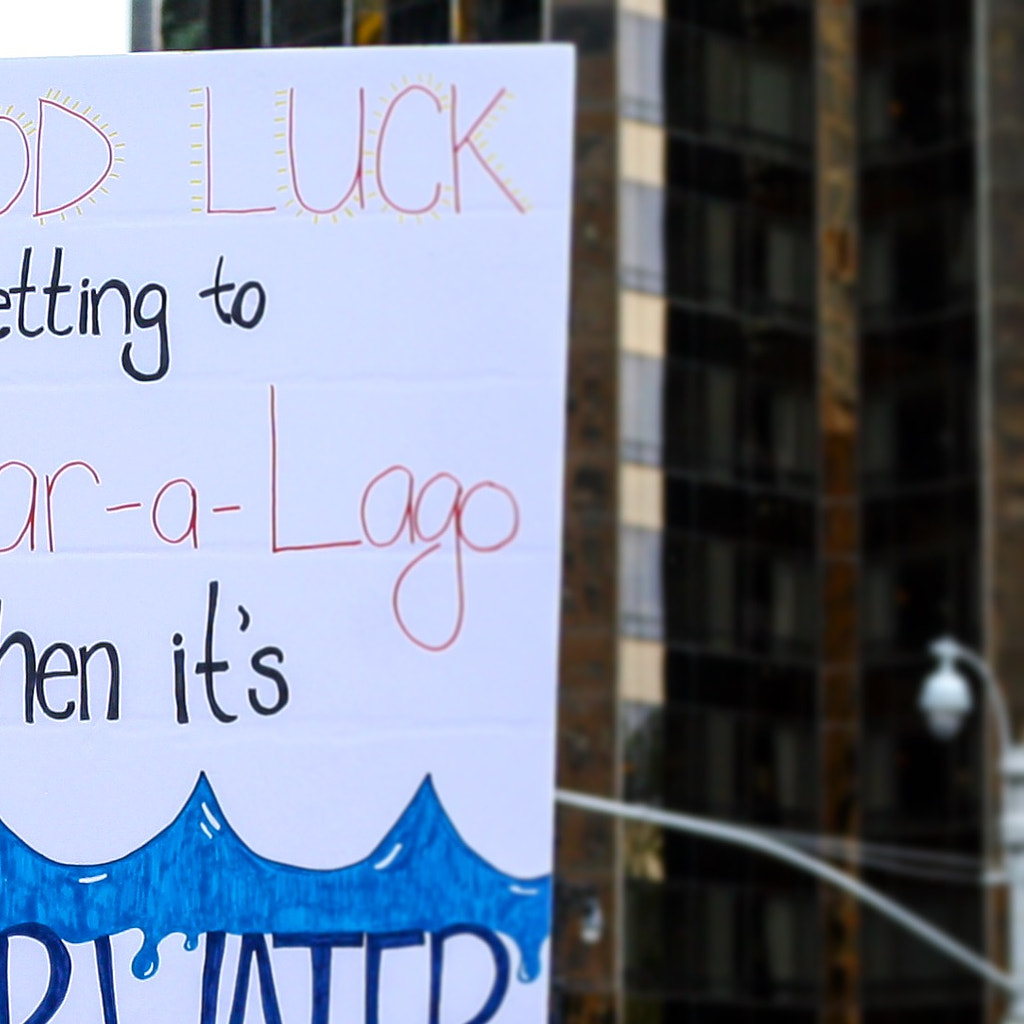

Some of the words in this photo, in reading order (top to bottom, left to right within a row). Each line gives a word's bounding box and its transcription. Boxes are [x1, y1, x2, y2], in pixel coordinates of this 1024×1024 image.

[206, 84, 527, 214] LUCK
[199, 256, 267, 328] to
[172, 581, 289, 724] it's
